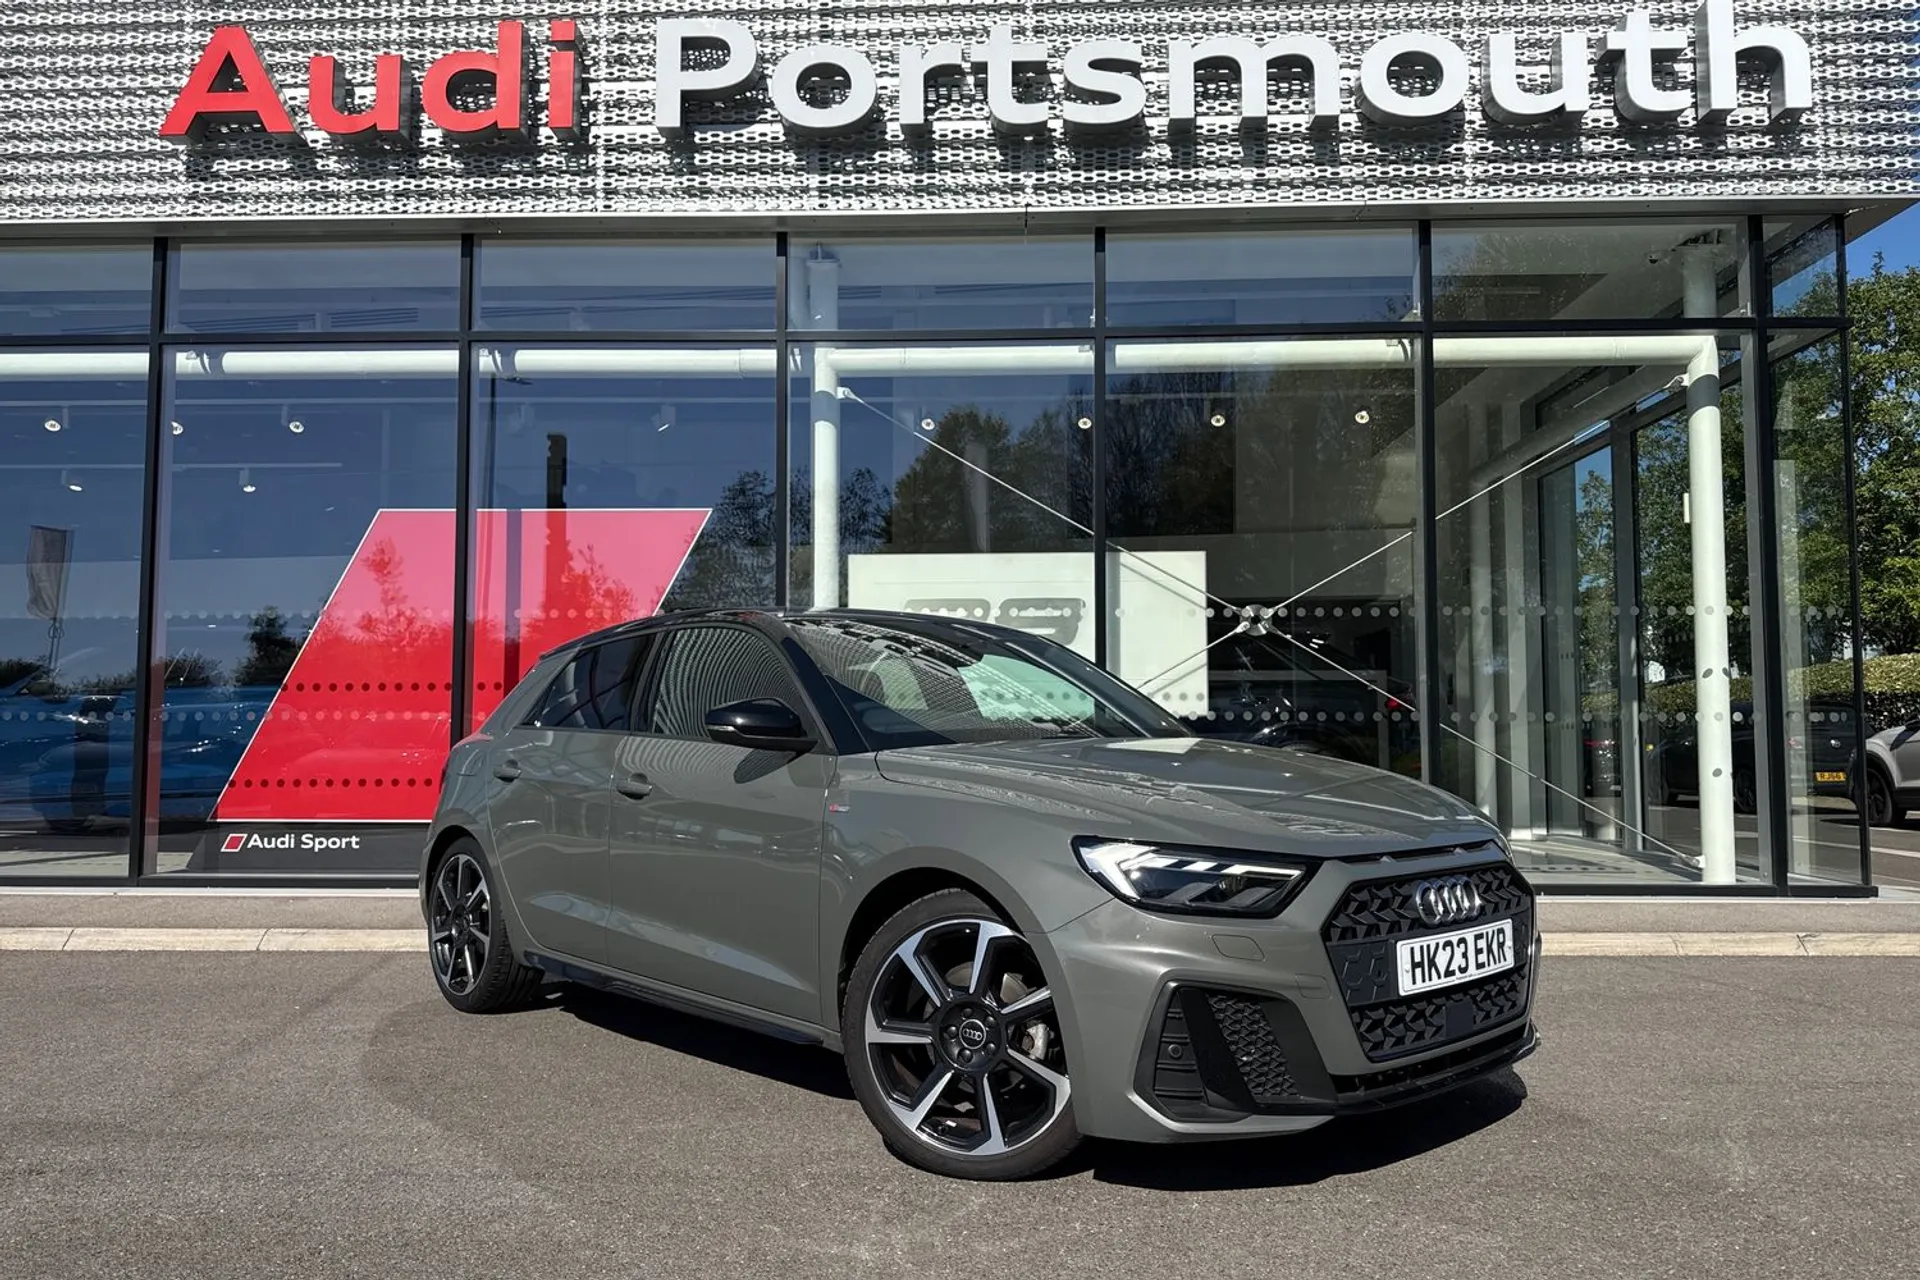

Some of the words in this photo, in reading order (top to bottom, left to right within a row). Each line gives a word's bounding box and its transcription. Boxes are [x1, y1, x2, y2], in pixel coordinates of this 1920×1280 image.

[159, 20, 577, 137] Audi
[655, 0, 1812, 129] Portsmouth
[246, 833, 296, 849] Audi
[300, 833, 360, 853] Sport
[1409, 936, 1470, 986] HK23
[1473, 926, 1508, 971] EKR
